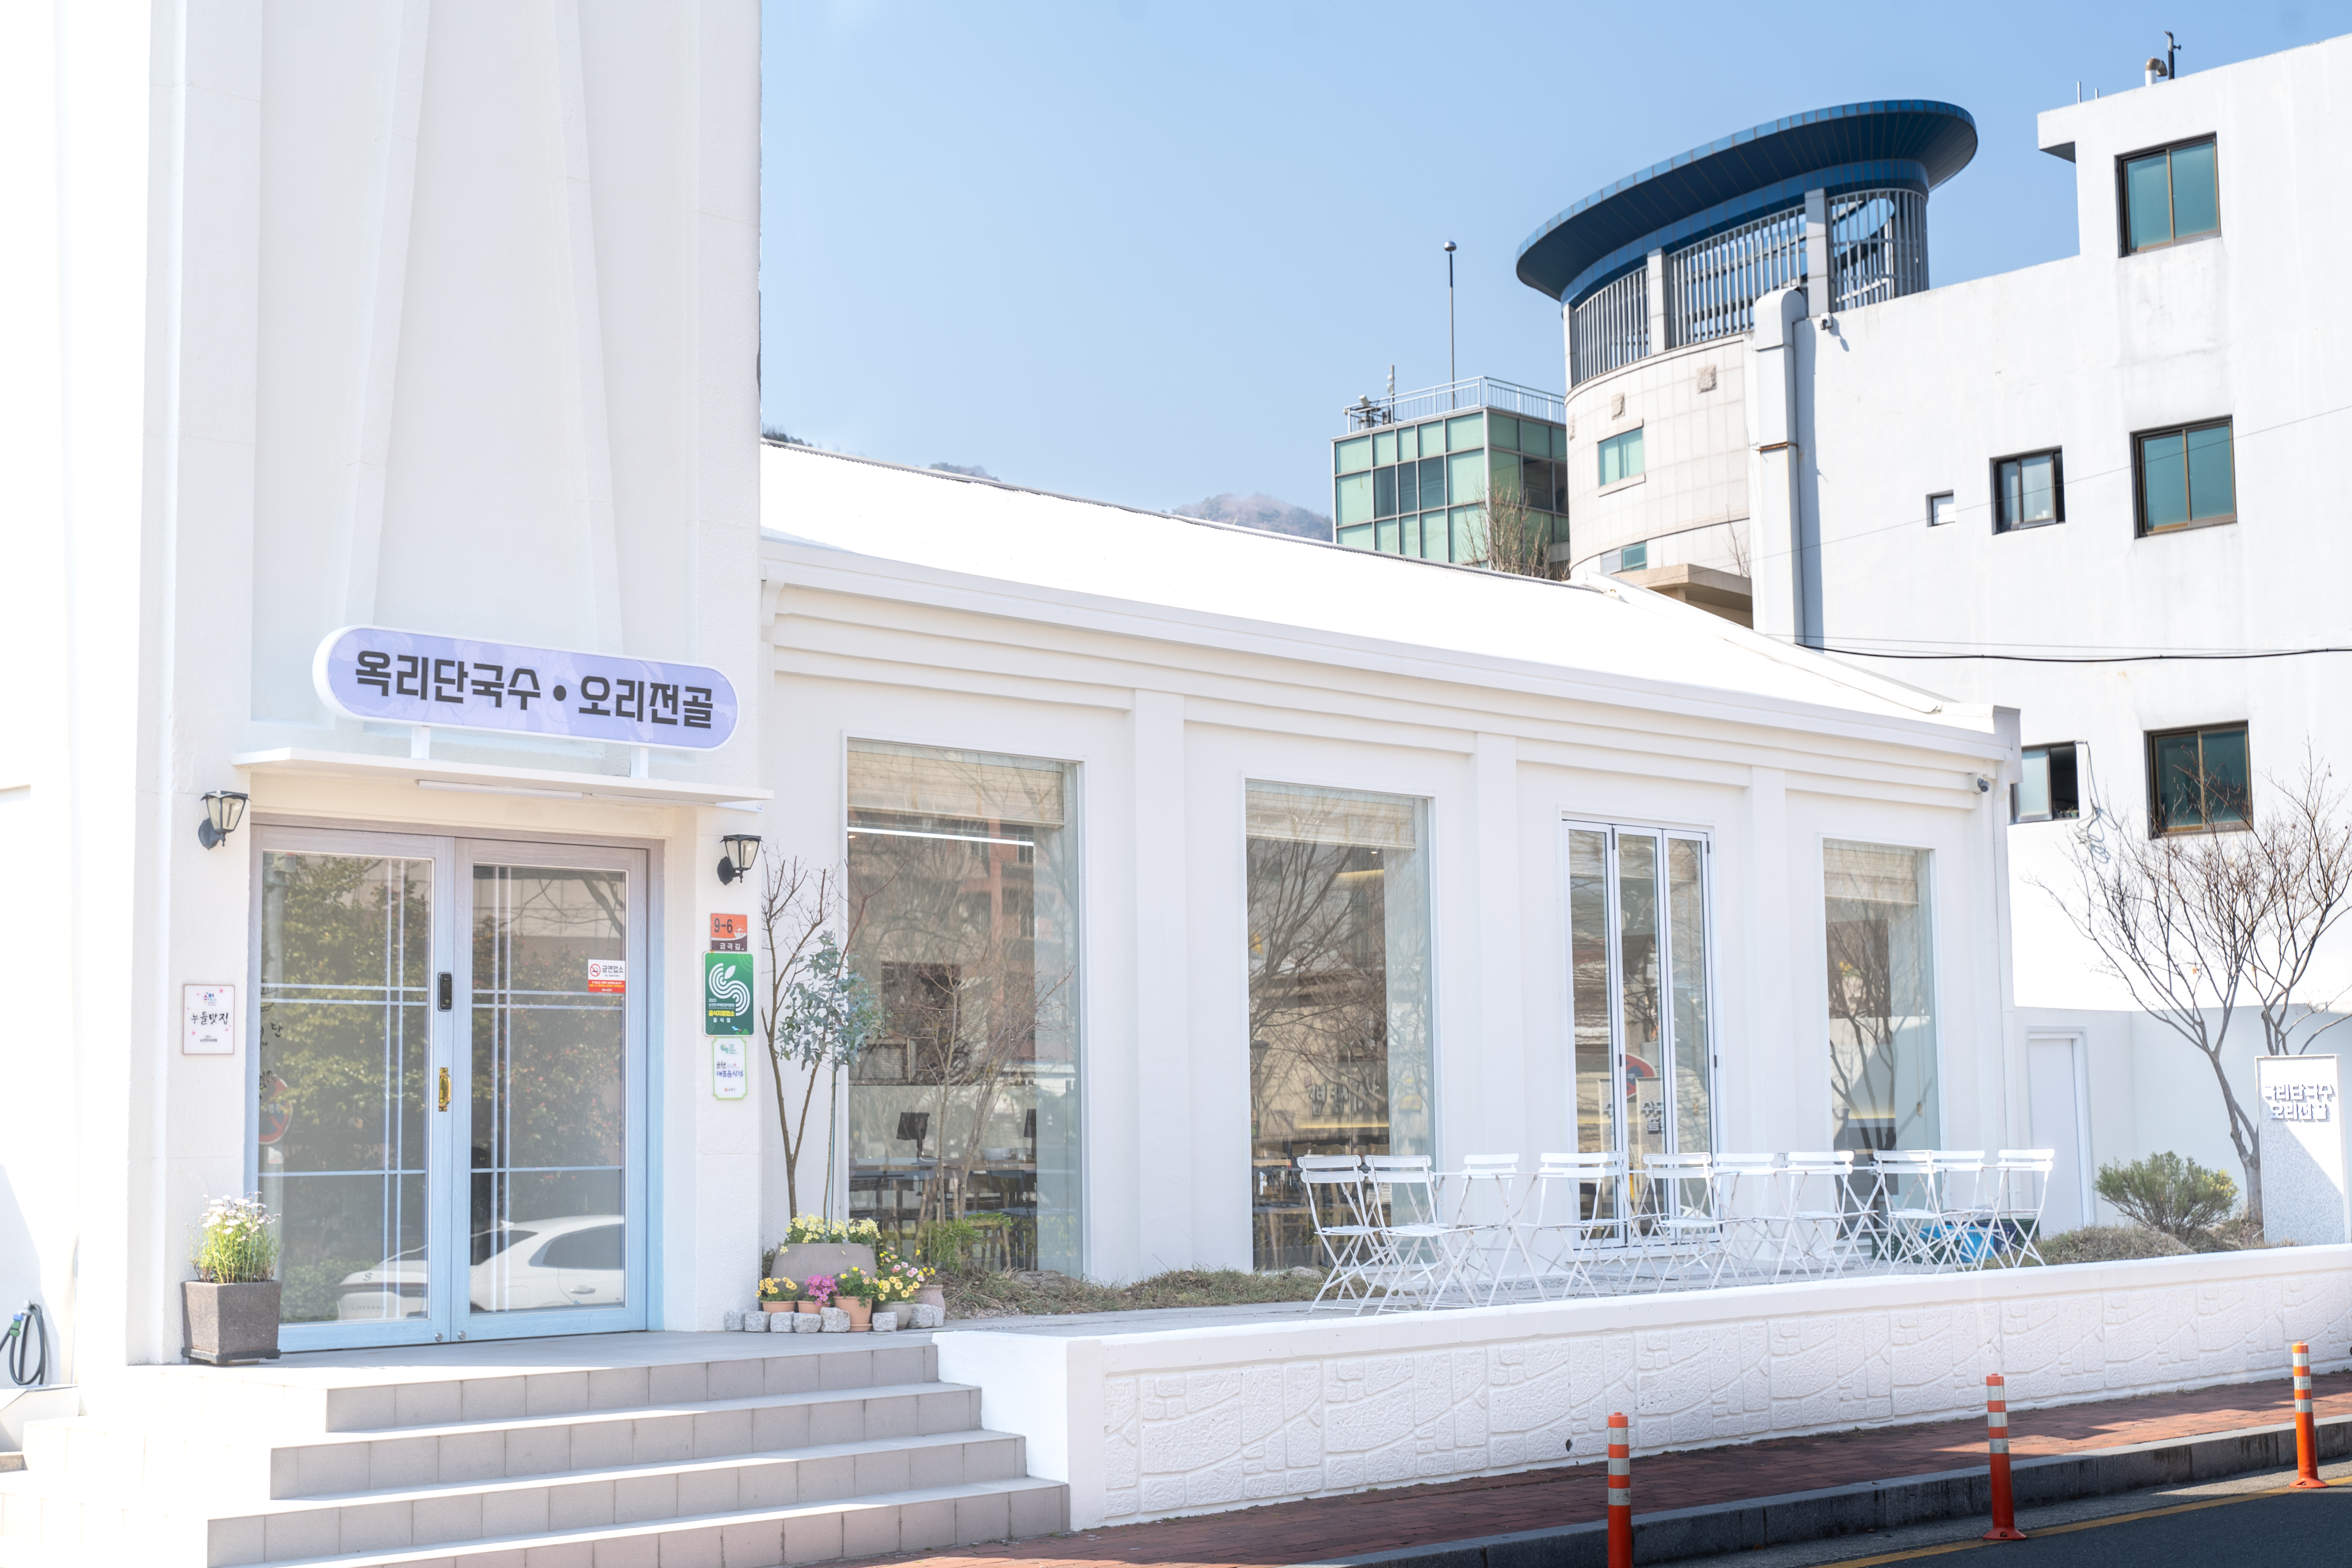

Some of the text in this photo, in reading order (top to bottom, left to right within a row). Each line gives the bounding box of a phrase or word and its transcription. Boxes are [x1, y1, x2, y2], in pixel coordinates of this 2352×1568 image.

[355, 650, 713, 729] 옥리단국수 오리전골
[714, 918, 733, 934] 9-6
[602, 965, 624, 973] 금연업소
[191, 1011, 228, 1025] 누들맛집
[716, 1070, 743, 1078] 대표음식점
